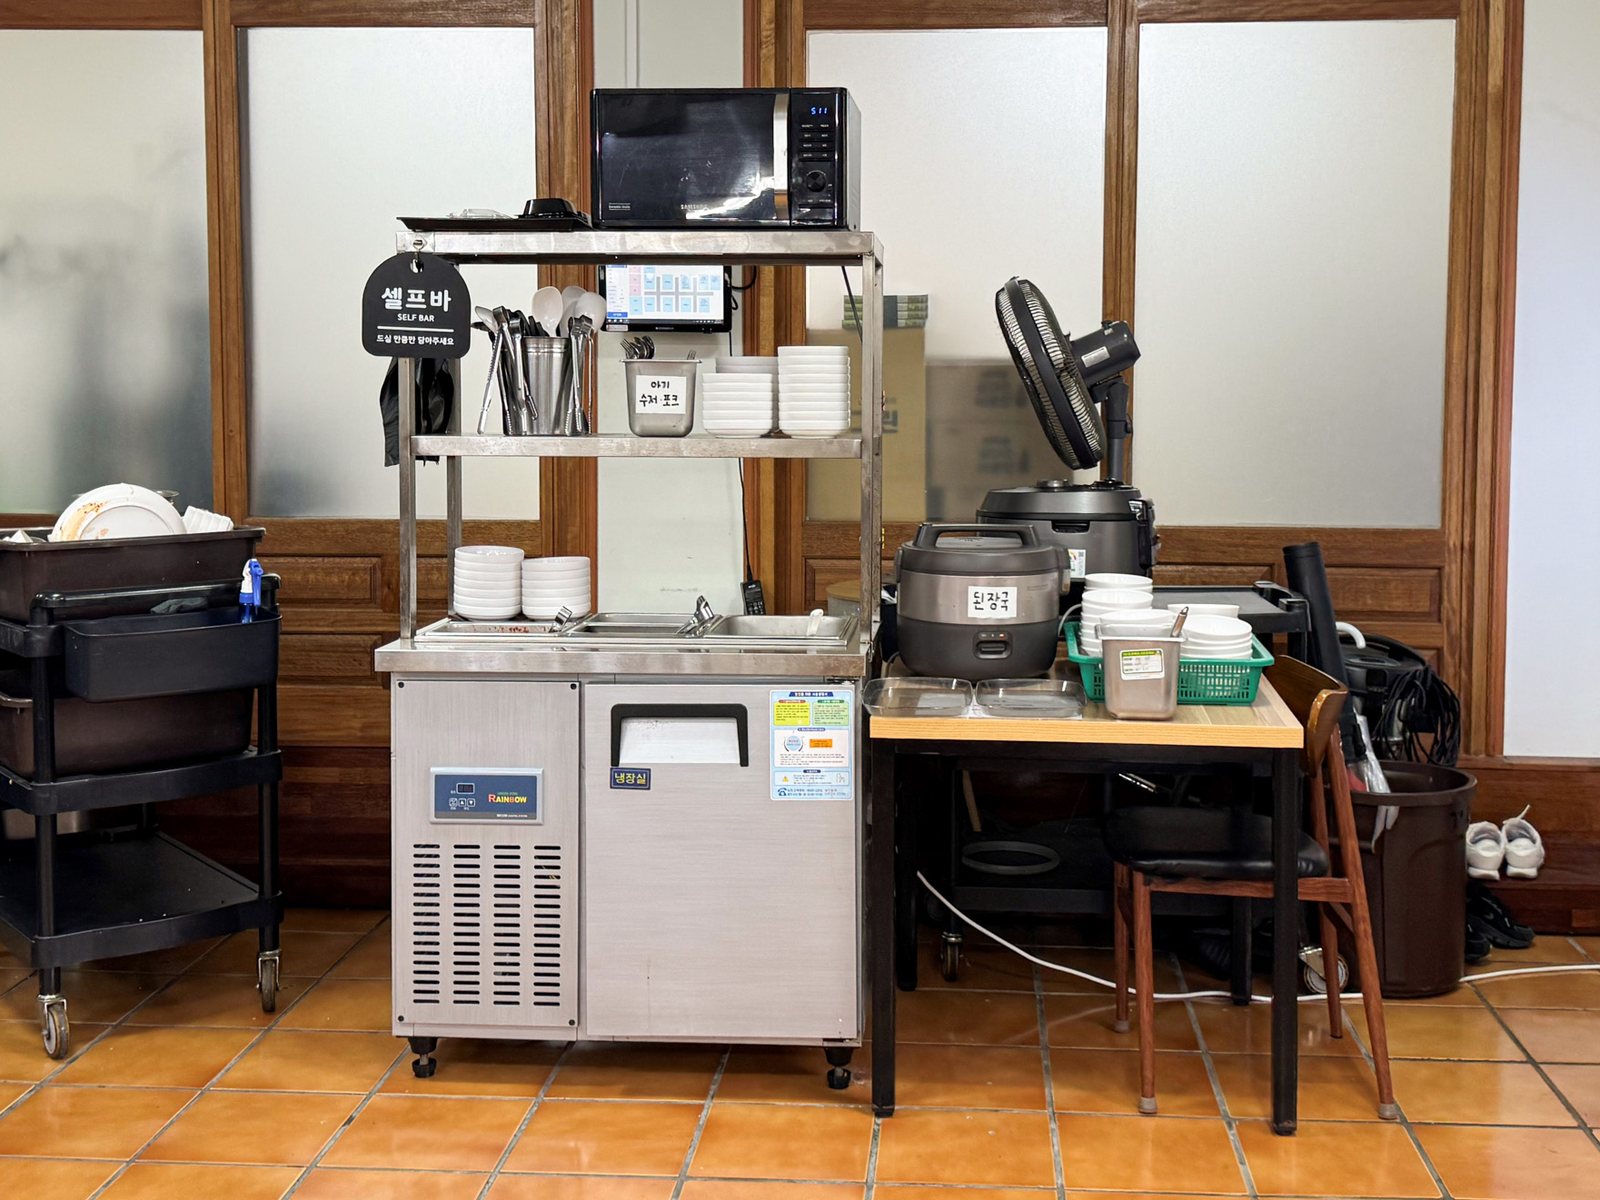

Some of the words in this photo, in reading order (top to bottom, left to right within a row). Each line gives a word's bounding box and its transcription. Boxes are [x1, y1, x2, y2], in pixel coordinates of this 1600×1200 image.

[381, 287, 452, 312] 셀프바
[397, 313, 417, 321] SELF
[418, 314, 435, 322] BAR
[376, 334, 392, 344] 드실
[393, 335, 416, 345] 만큼만
[417, 336, 455, 346] 담아주세요
[650, 380, 670, 389] 아기
[973, 591, 1009, 612] 된장국
[614, 772, 647, 785] 냉장실
[488, 793, 527, 803] RAINBOW
